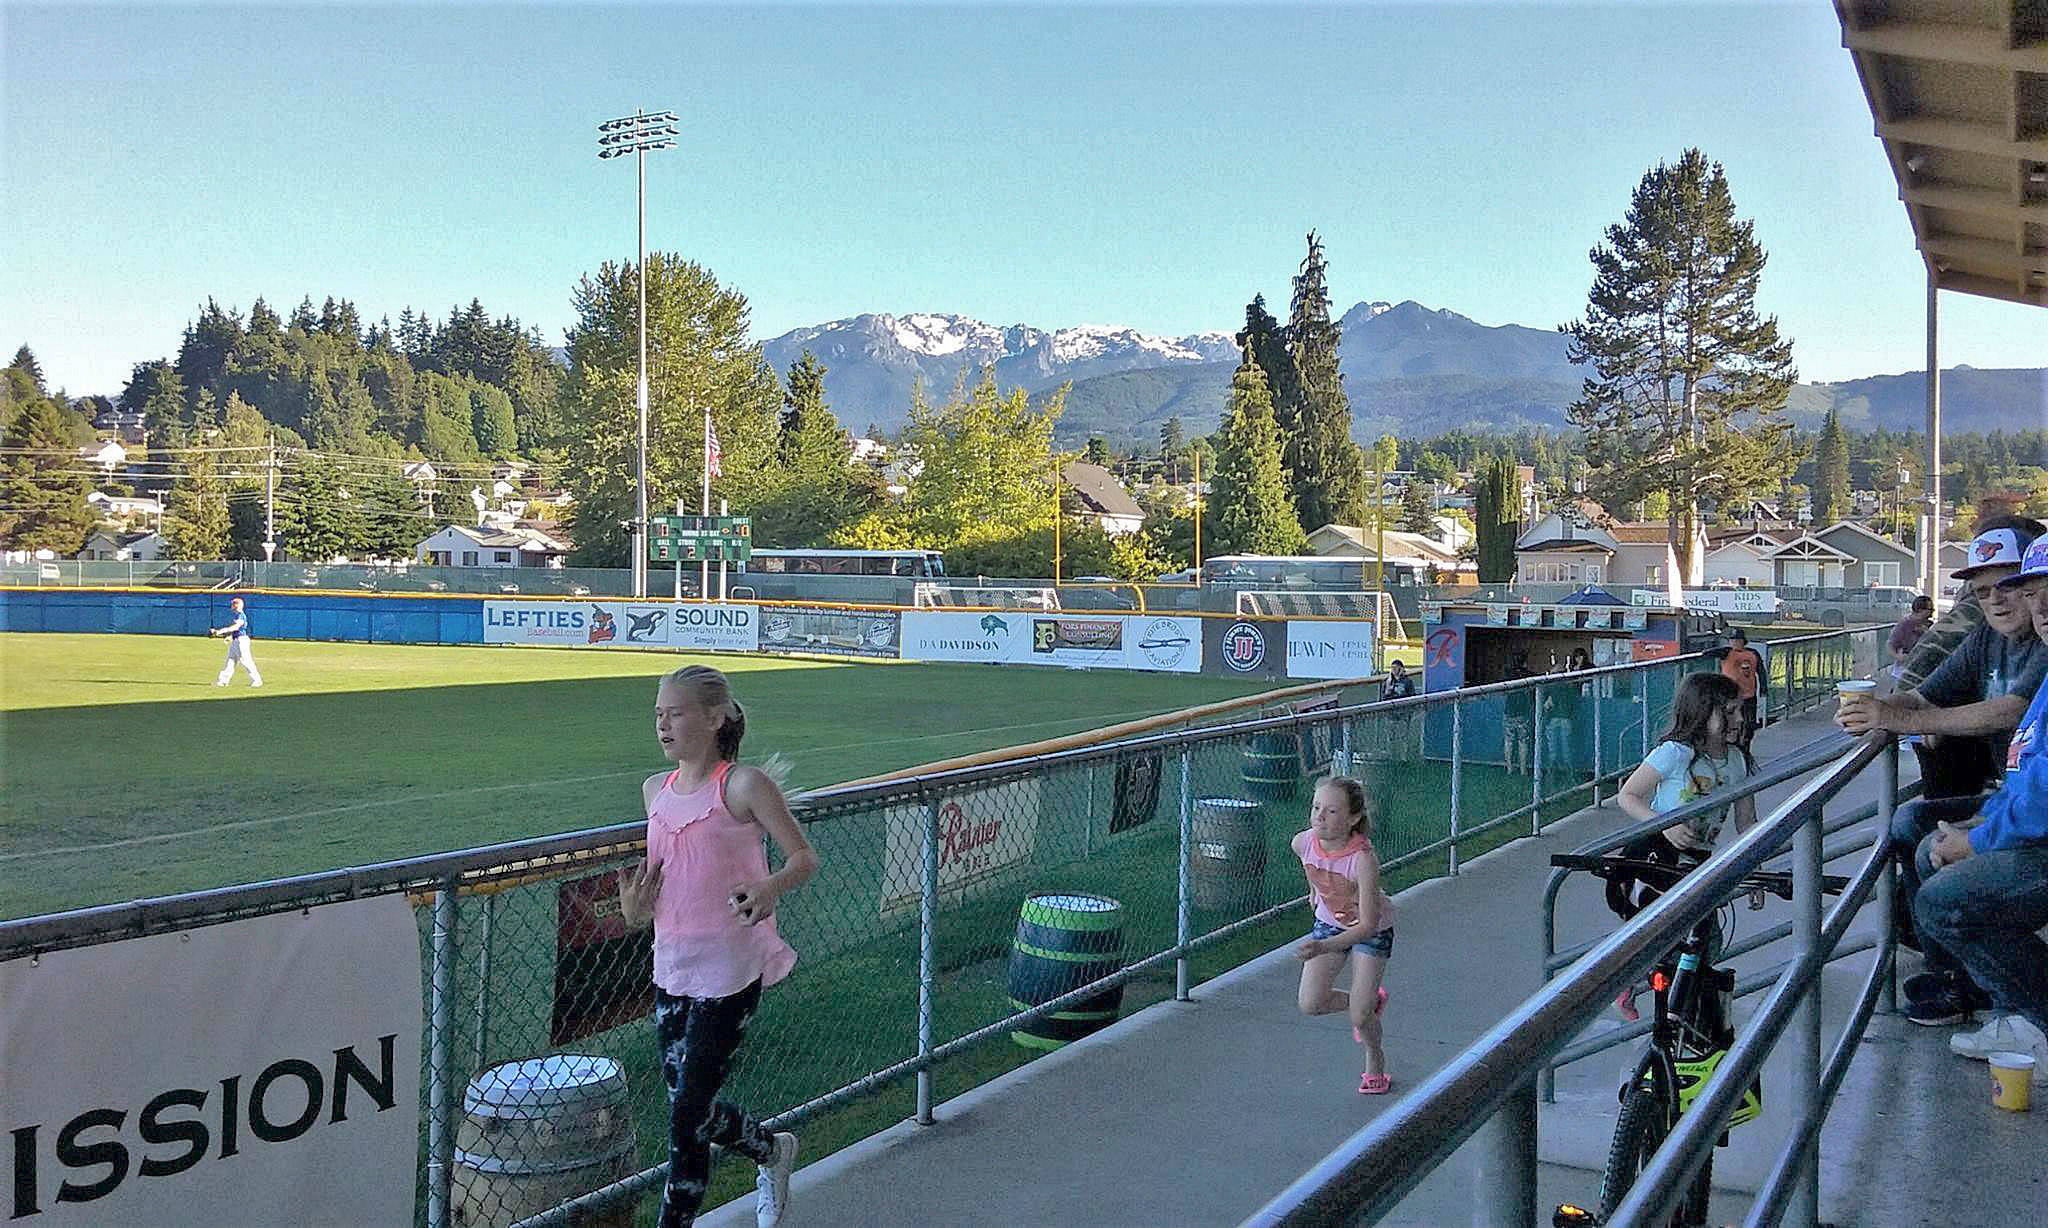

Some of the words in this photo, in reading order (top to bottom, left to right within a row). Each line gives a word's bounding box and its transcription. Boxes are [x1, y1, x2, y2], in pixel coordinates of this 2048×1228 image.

[1651, 595, 1671, 607] Firs
[1684, 596, 1719, 607] ederal
[1734, 592, 1761, 601] KIDS
[1734, 603, 1763, 611] AREA
[674, 608, 750, 627] SOUND
[674, 626, 723, 635] COMMUNITY
[726, 626, 750, 636] BANK
[939, 640, 1000, 651] DAVIDSON
[1233, 636, 1254, 660] JJ
[937, 801, 1002, 869] Rainier
